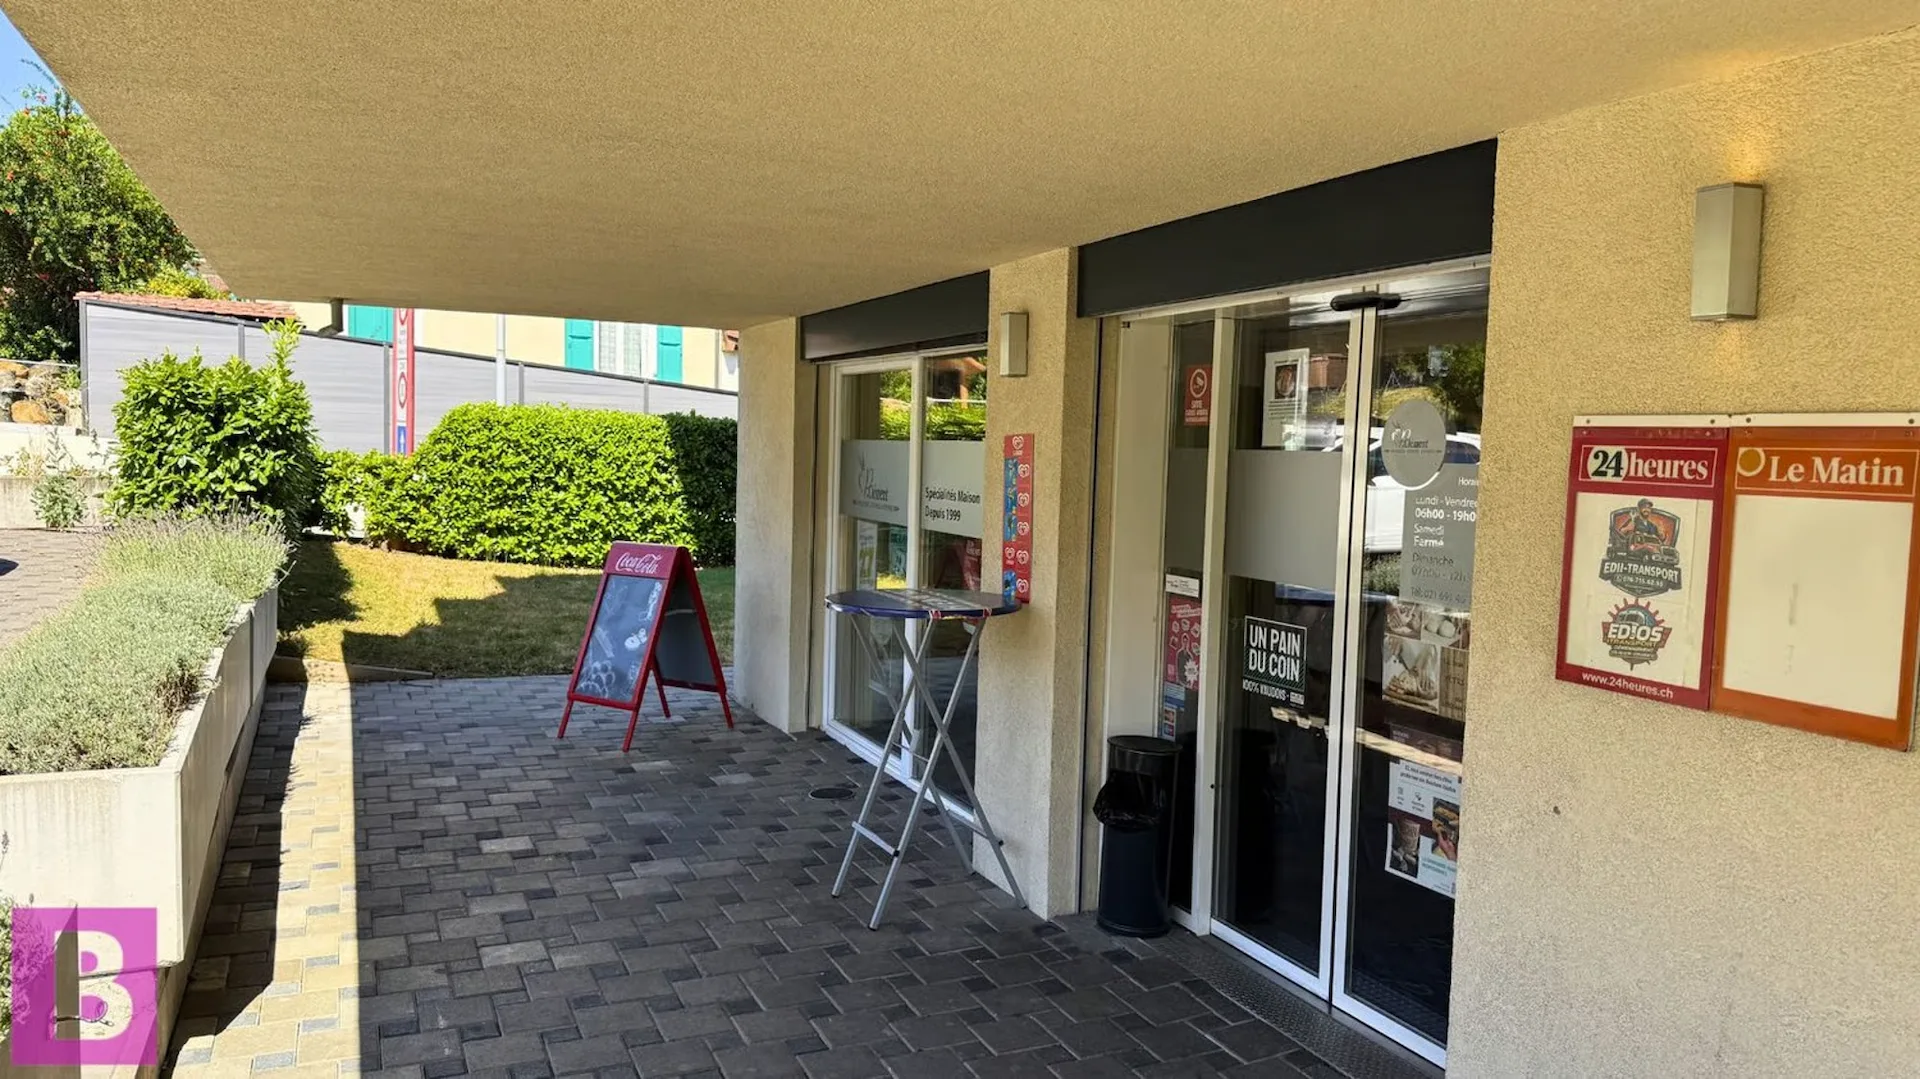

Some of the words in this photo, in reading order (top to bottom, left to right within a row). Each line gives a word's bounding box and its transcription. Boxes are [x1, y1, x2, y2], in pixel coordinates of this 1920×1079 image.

[1768, 455, 1805, 482] Le
[1811, 456, 1905, 487] Matin
[957, 489, 981, 504] Maison
[924, 504, 946, 521] Depuis
[946, 508, 961, 522] 1999
[1415, 507, 1445, 520] 06h00
[1413, 523, 1445, 536] Samedi
[1249, 623, 1267, 650] UN
[1270, 628, 1301, 658] PAIN
[1248, 648, 1267, 674] DU
[1268, 652, 1301, 682] COIN
[1581, 671, 1674, 699] www.24heures.ch
